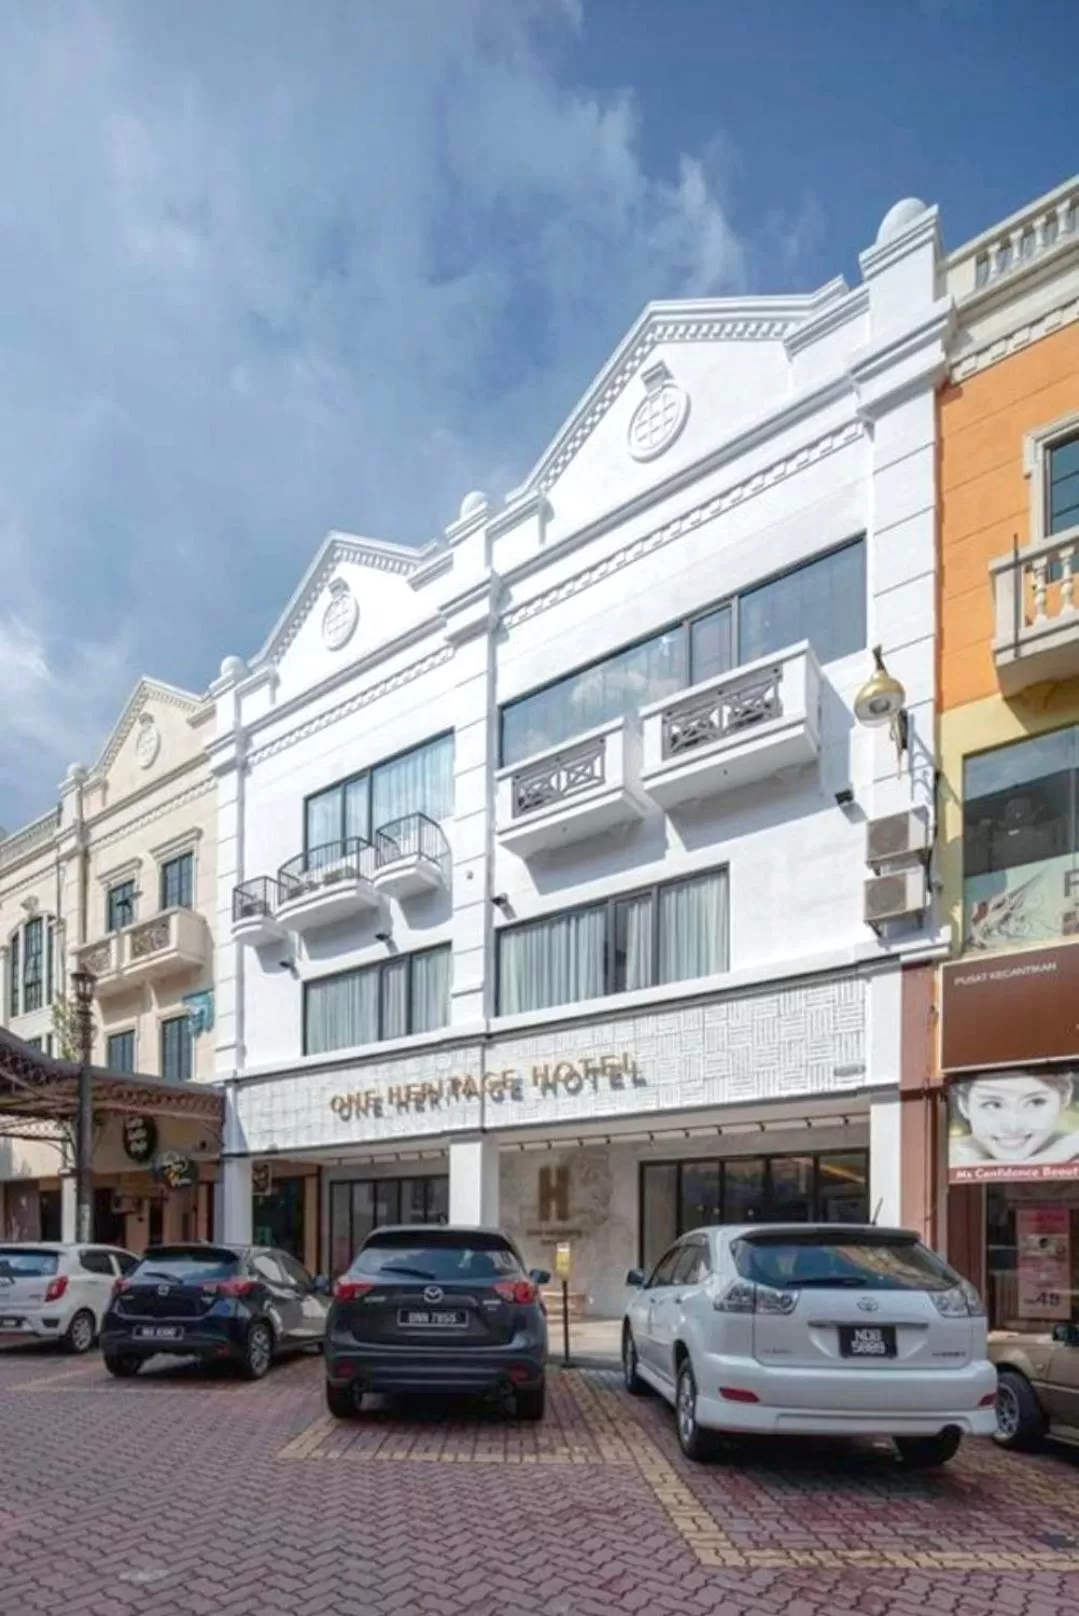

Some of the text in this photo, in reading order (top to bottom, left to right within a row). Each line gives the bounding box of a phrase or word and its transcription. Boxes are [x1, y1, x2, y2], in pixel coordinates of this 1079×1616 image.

[330, 1051, 640, 1115] ONE HERITAGE HOTEL
[975, 1167, 1039, 1179] Confidence
